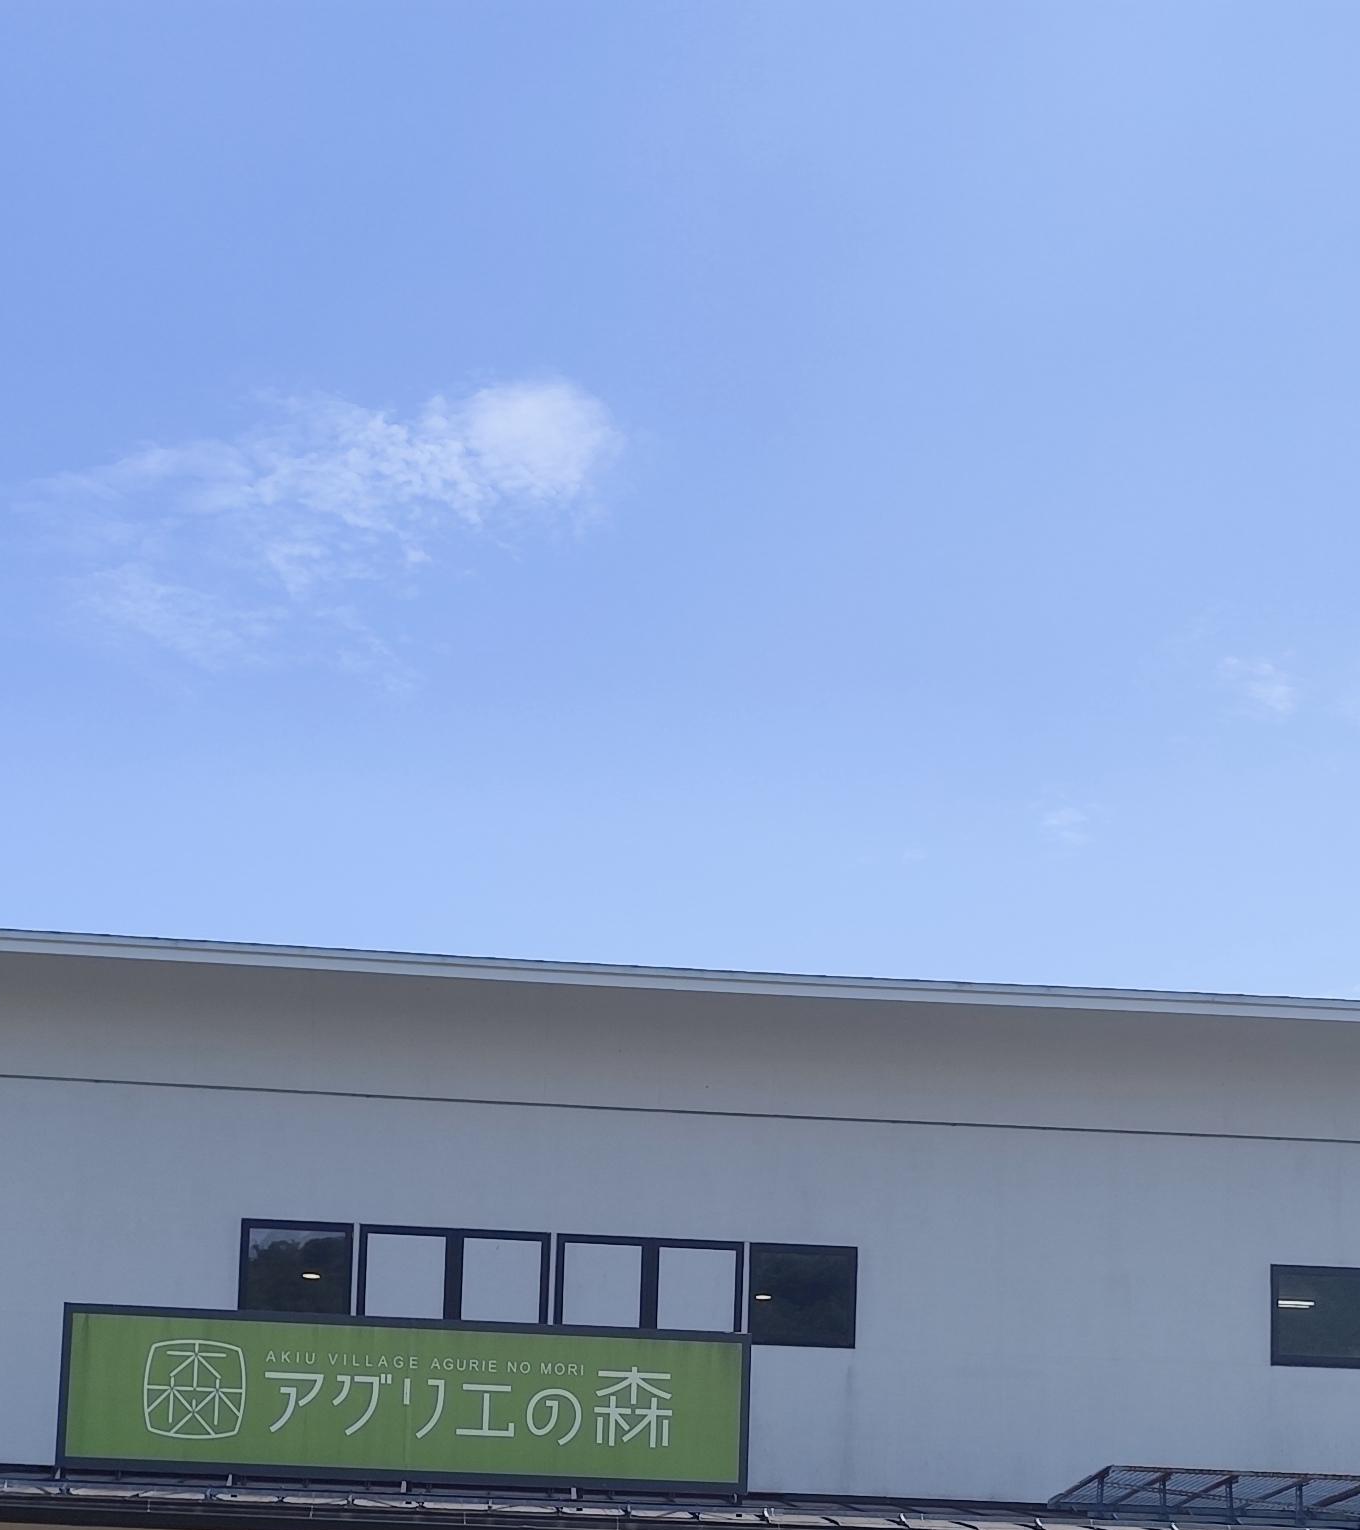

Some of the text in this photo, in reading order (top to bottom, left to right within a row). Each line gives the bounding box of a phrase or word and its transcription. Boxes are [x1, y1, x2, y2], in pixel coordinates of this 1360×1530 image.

[265, 1350, 585, 1376] AKIU VILLAGE AGURIE NO MORI
[264, 1366, 674, 1448] アグリエの森
